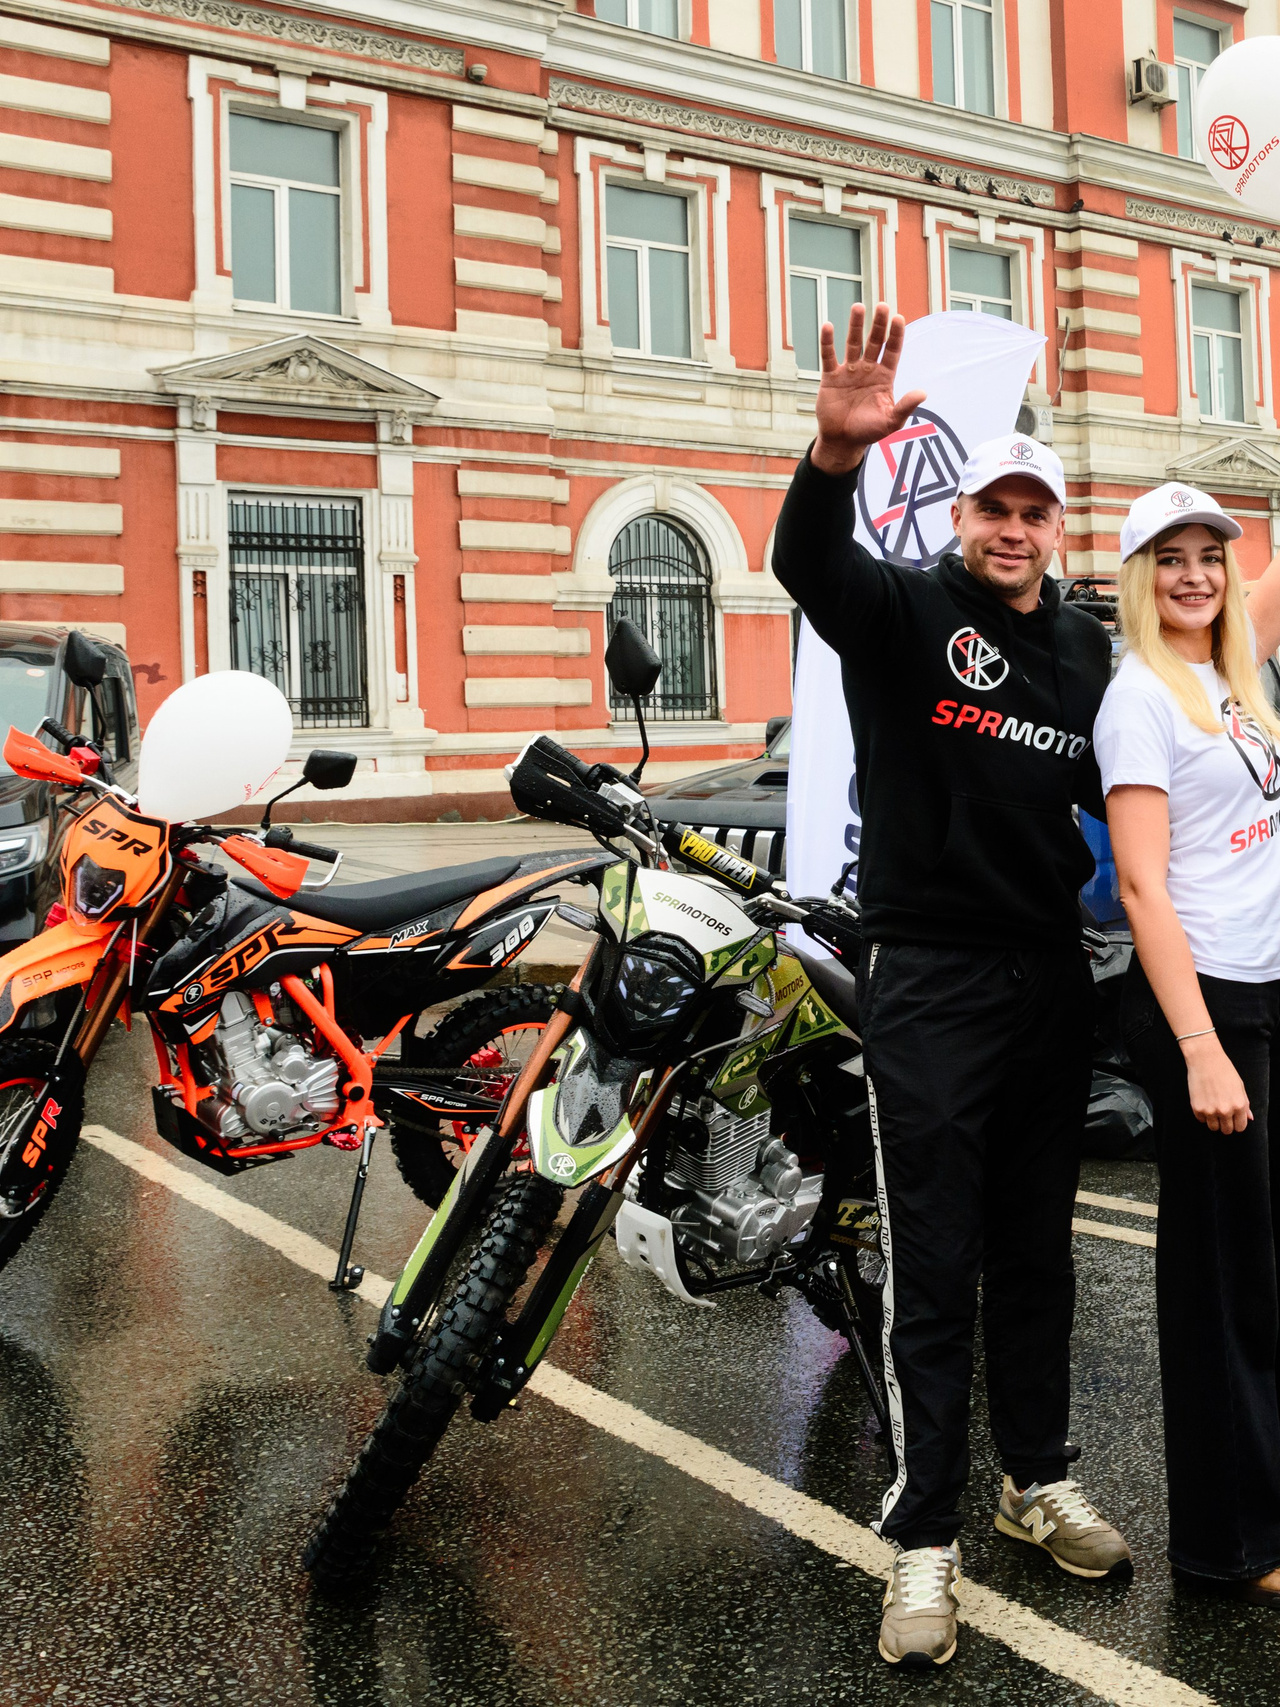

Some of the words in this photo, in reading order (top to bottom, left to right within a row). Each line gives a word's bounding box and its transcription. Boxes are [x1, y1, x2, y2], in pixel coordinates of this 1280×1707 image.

[1234, 136, 1280, 196] SPRMOTORS
[998, 460, 1042, 471] SPRMOTORS
[931, 699, 1091, 760] SPRMOTO
[82, 819, 153, 857] SPR
[684, 834, 755, 885] PROTAPER
[388, 920, 429, 953] MAX
[653, 892, 733, 936] SPRMOTORS
[490, 914, 534, 967] 300
[22, 1097, 63, 1169] SPR
[891, 1414, 902, 1450] JUST
